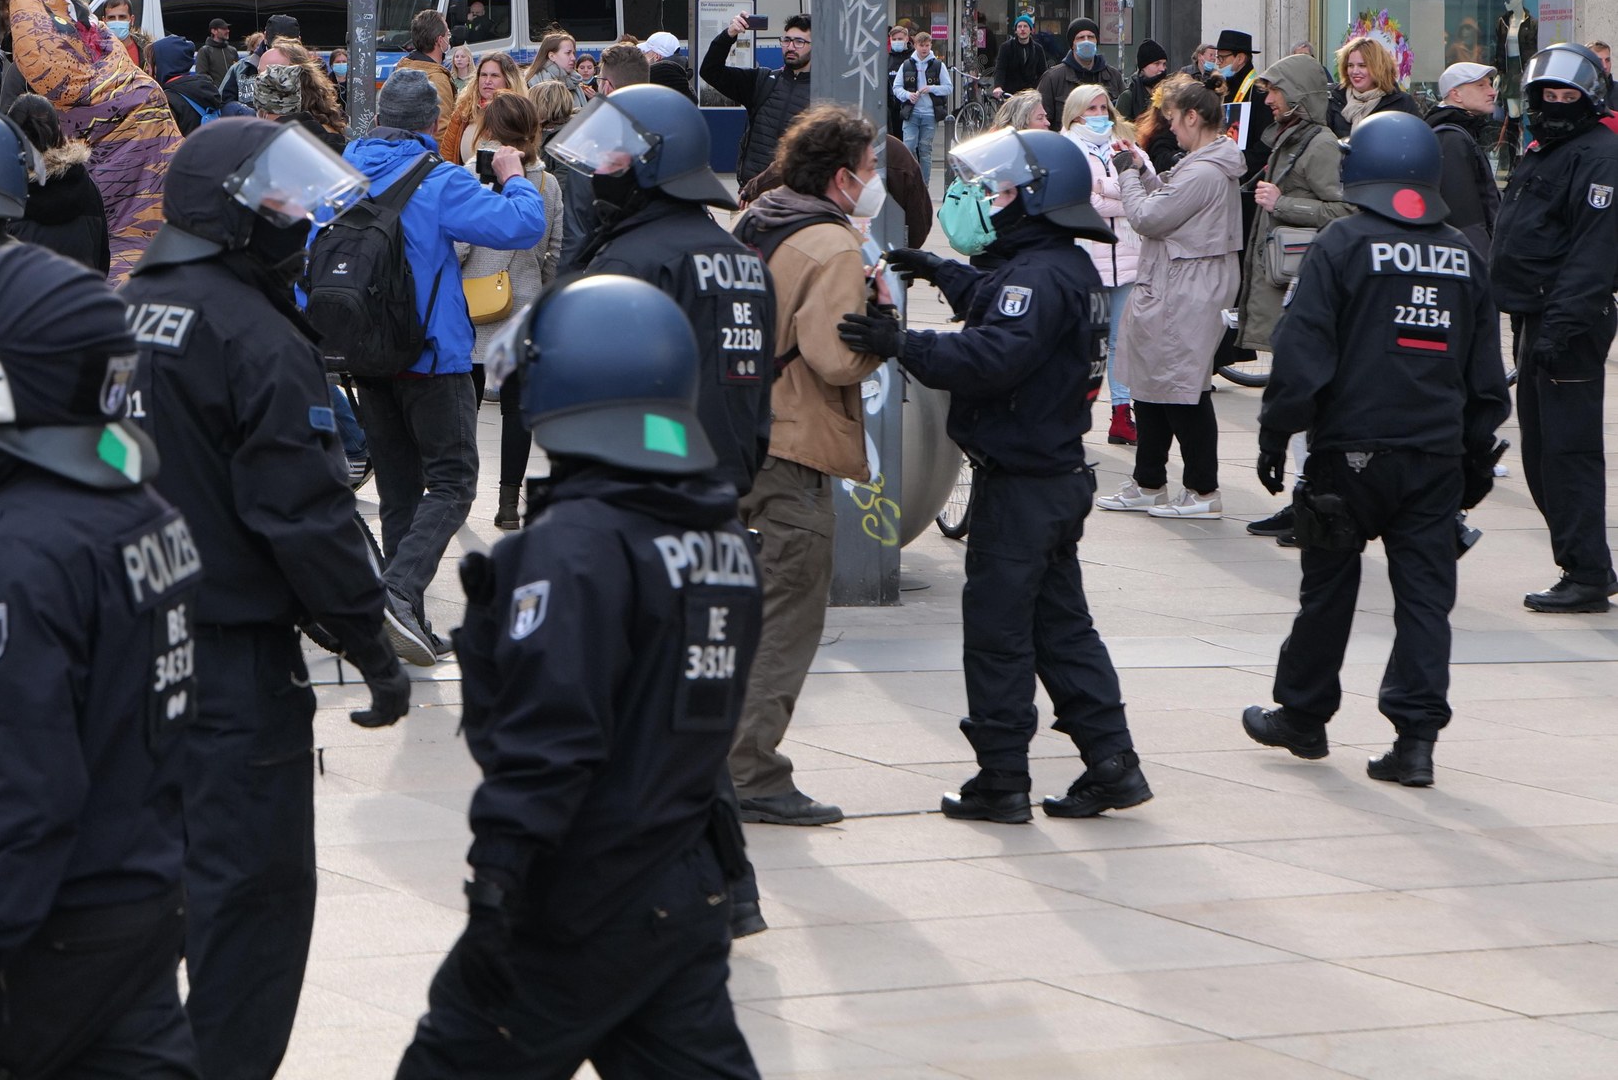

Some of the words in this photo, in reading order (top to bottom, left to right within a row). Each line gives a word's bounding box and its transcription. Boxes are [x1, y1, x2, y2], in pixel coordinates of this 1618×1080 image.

[693, 252, 767, 291] POLIZEI
[1370, 242, 1471, 278] POLIZEI
[1411, 285, 1438, 306] BE
[732, 302, 753, 325] BE
[1393, 305, 1451, 328] 22134
[721, 327, 763, 351] 22130
